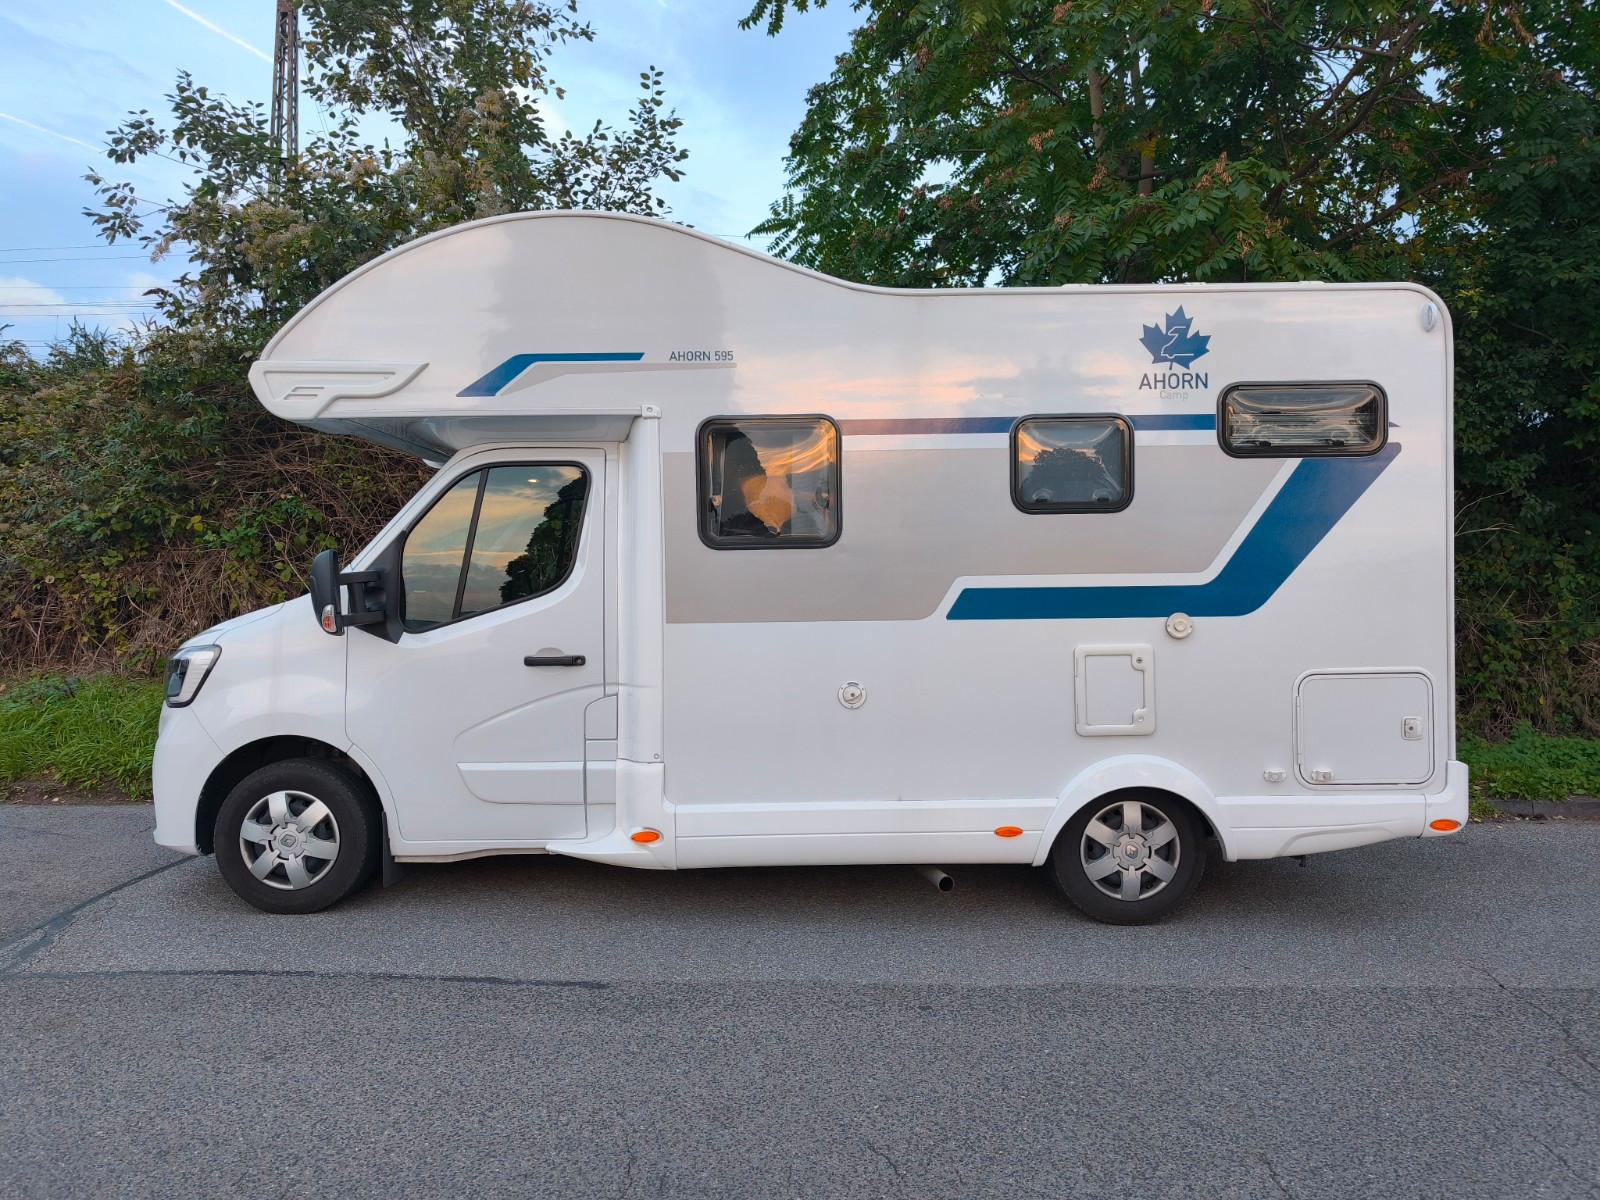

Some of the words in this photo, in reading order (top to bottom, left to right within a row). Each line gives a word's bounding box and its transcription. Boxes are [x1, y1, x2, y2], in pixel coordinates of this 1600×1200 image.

[669, 350, 711, 361] AHORN
[714, 350, 734, 361] 595
[1138, 372, 1208, 390] AHORN
[1159, 390, 1189, 402] Camp
